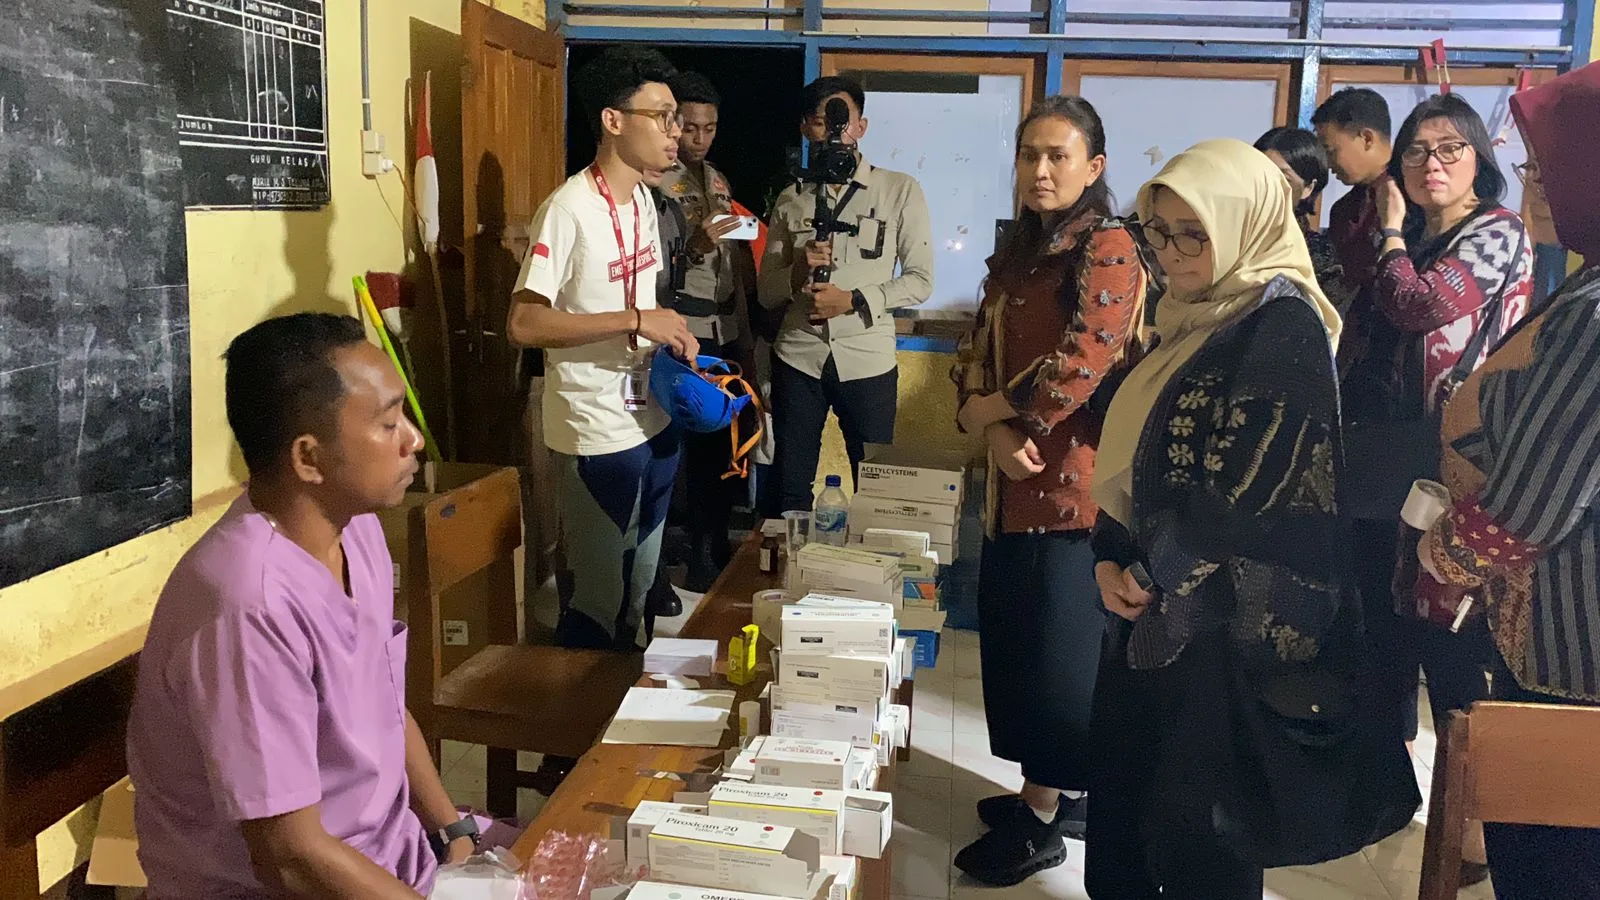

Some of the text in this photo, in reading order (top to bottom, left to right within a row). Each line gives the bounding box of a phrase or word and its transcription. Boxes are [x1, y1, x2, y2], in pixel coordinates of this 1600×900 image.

[250, 154, 308, 167] GURU KELAS
[861, 466, 918, 478] ACETYLCYSTEINE
[718, 785, 771, 797] Piroxicam
[666, 816, 720, 830] Piroxicam
